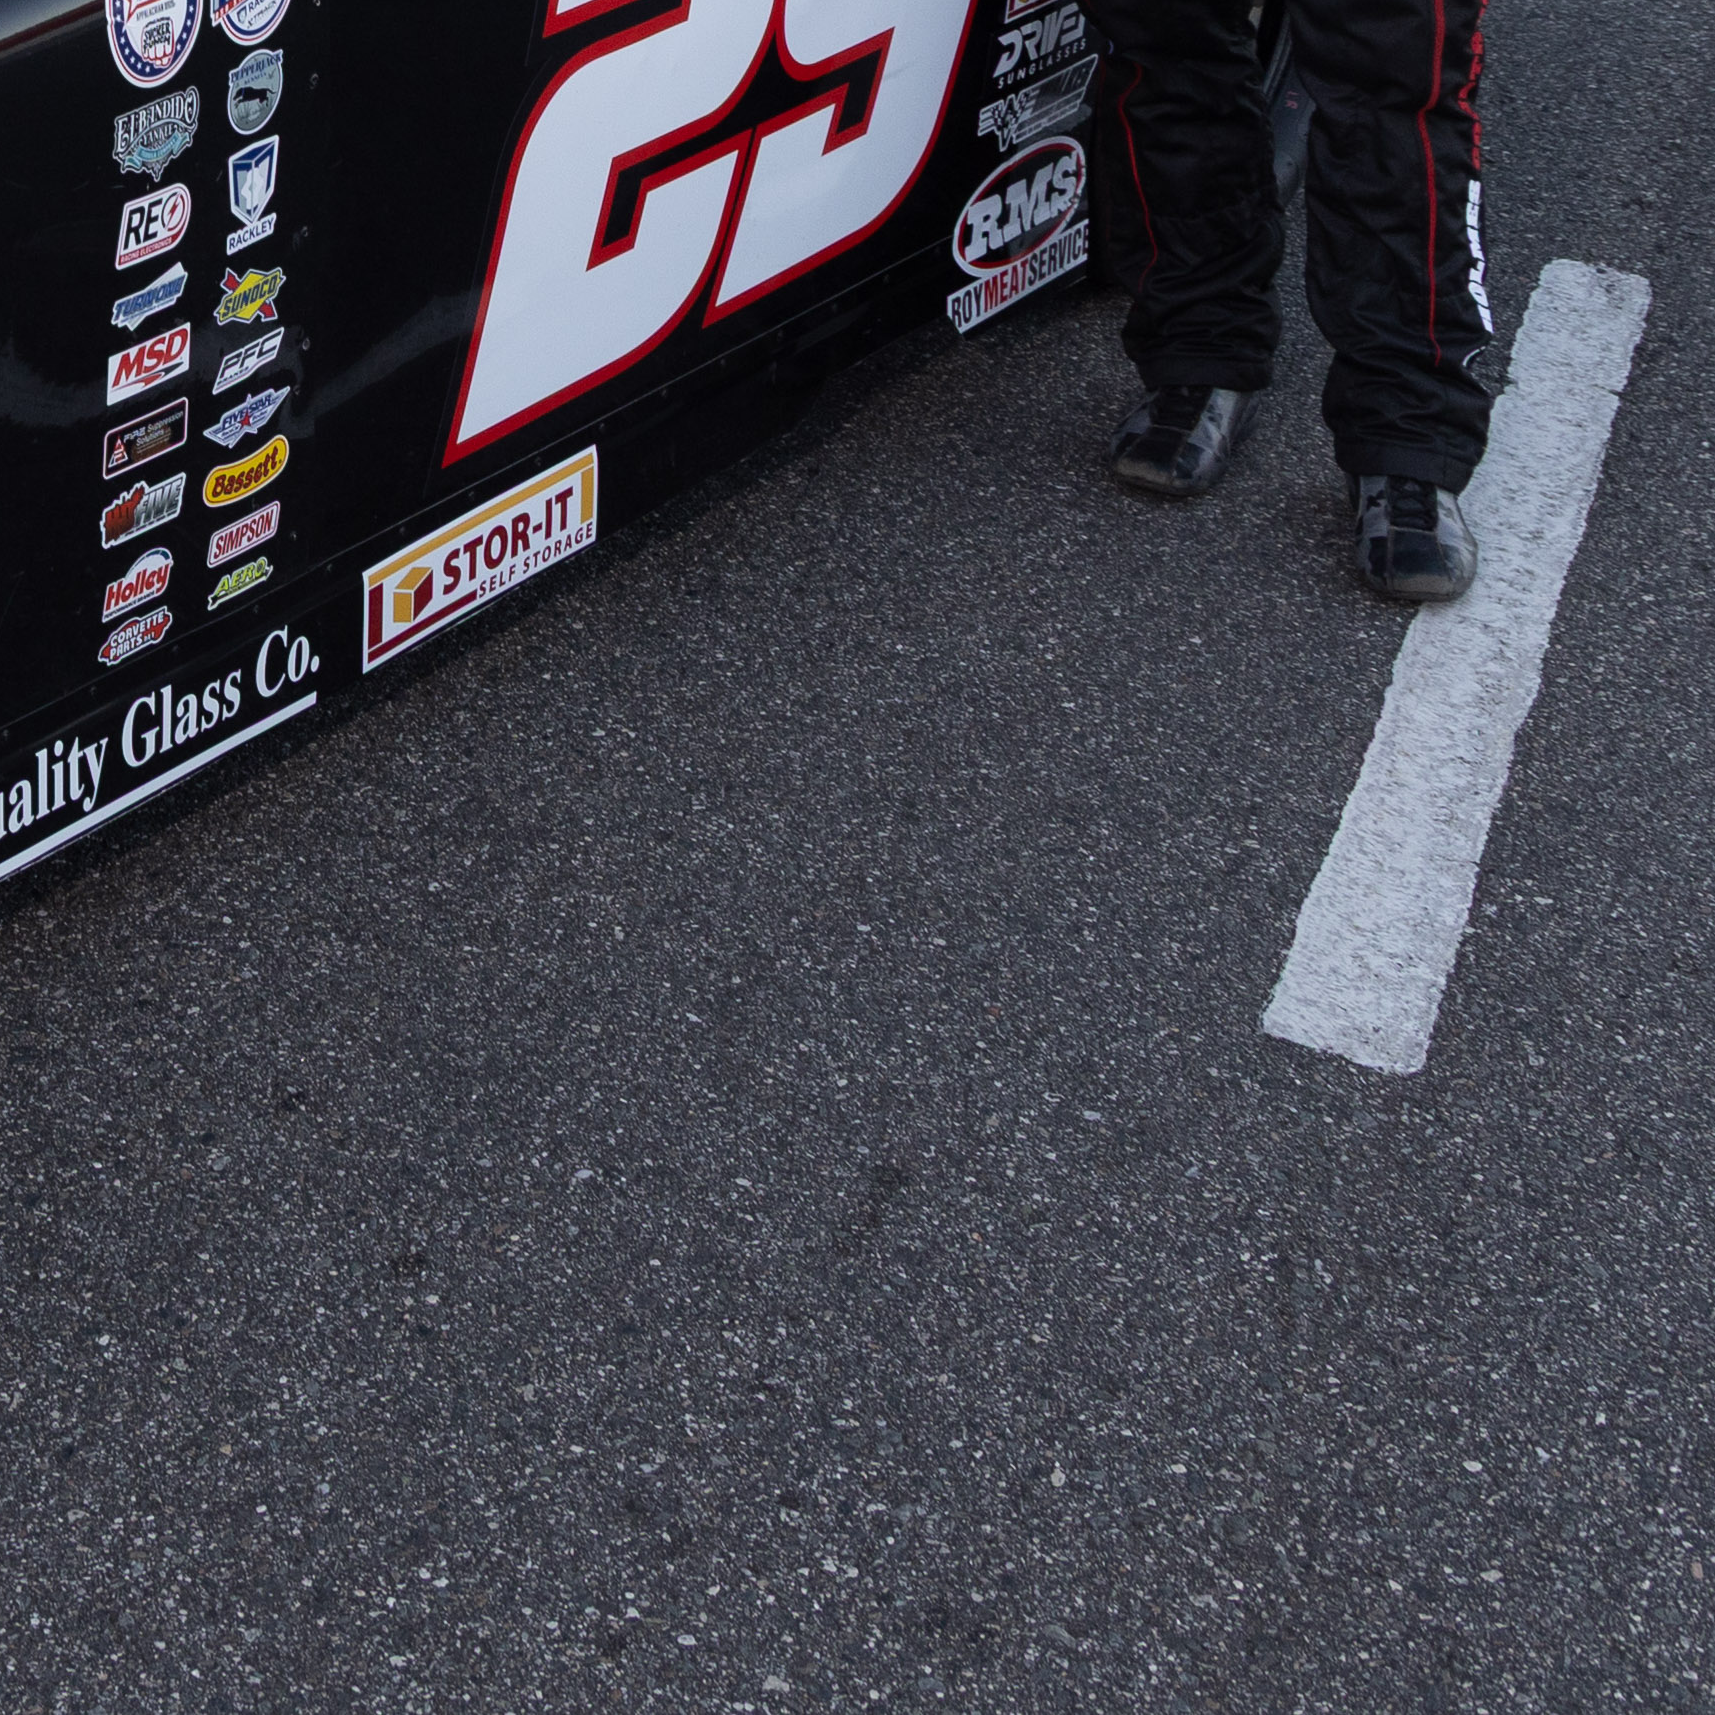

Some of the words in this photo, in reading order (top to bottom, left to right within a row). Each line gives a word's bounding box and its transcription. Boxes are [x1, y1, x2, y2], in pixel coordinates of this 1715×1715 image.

[998, 38, 1087, 89] SUNGLASSES
[964, 151, 1079, 264] RMS
[229, 217, 274, 250] RACKLEY
[222, 274, 278, 319] SUNOCO
[112, 328, 189, 389] MSD
[220, 328, 283, 379] PFC
[136, 430, 165, 446] Solutions
[147, 410, 184, 433] Suppression
[222, 407, 248, 431] FIVE
[248, 395, 273, 413] STAR
[212, 445, 279, 498] Bassett
[214, 509, 274, 560] SIMPSON
[443, 486, 574, 596] STOR-IT
[215, 558, 267, 596] AERO
[479, 565, 517, 599] SELF
[522, 521, 594, 575] STORAGE
[105, 563, 170, 612] Holley
[109, 633, 143, 660] PARTS
[110, 610, 165, 647] CORVETTE
[121, 668, 241, 769] Glass
[256, 625, 320, 699] Co.
